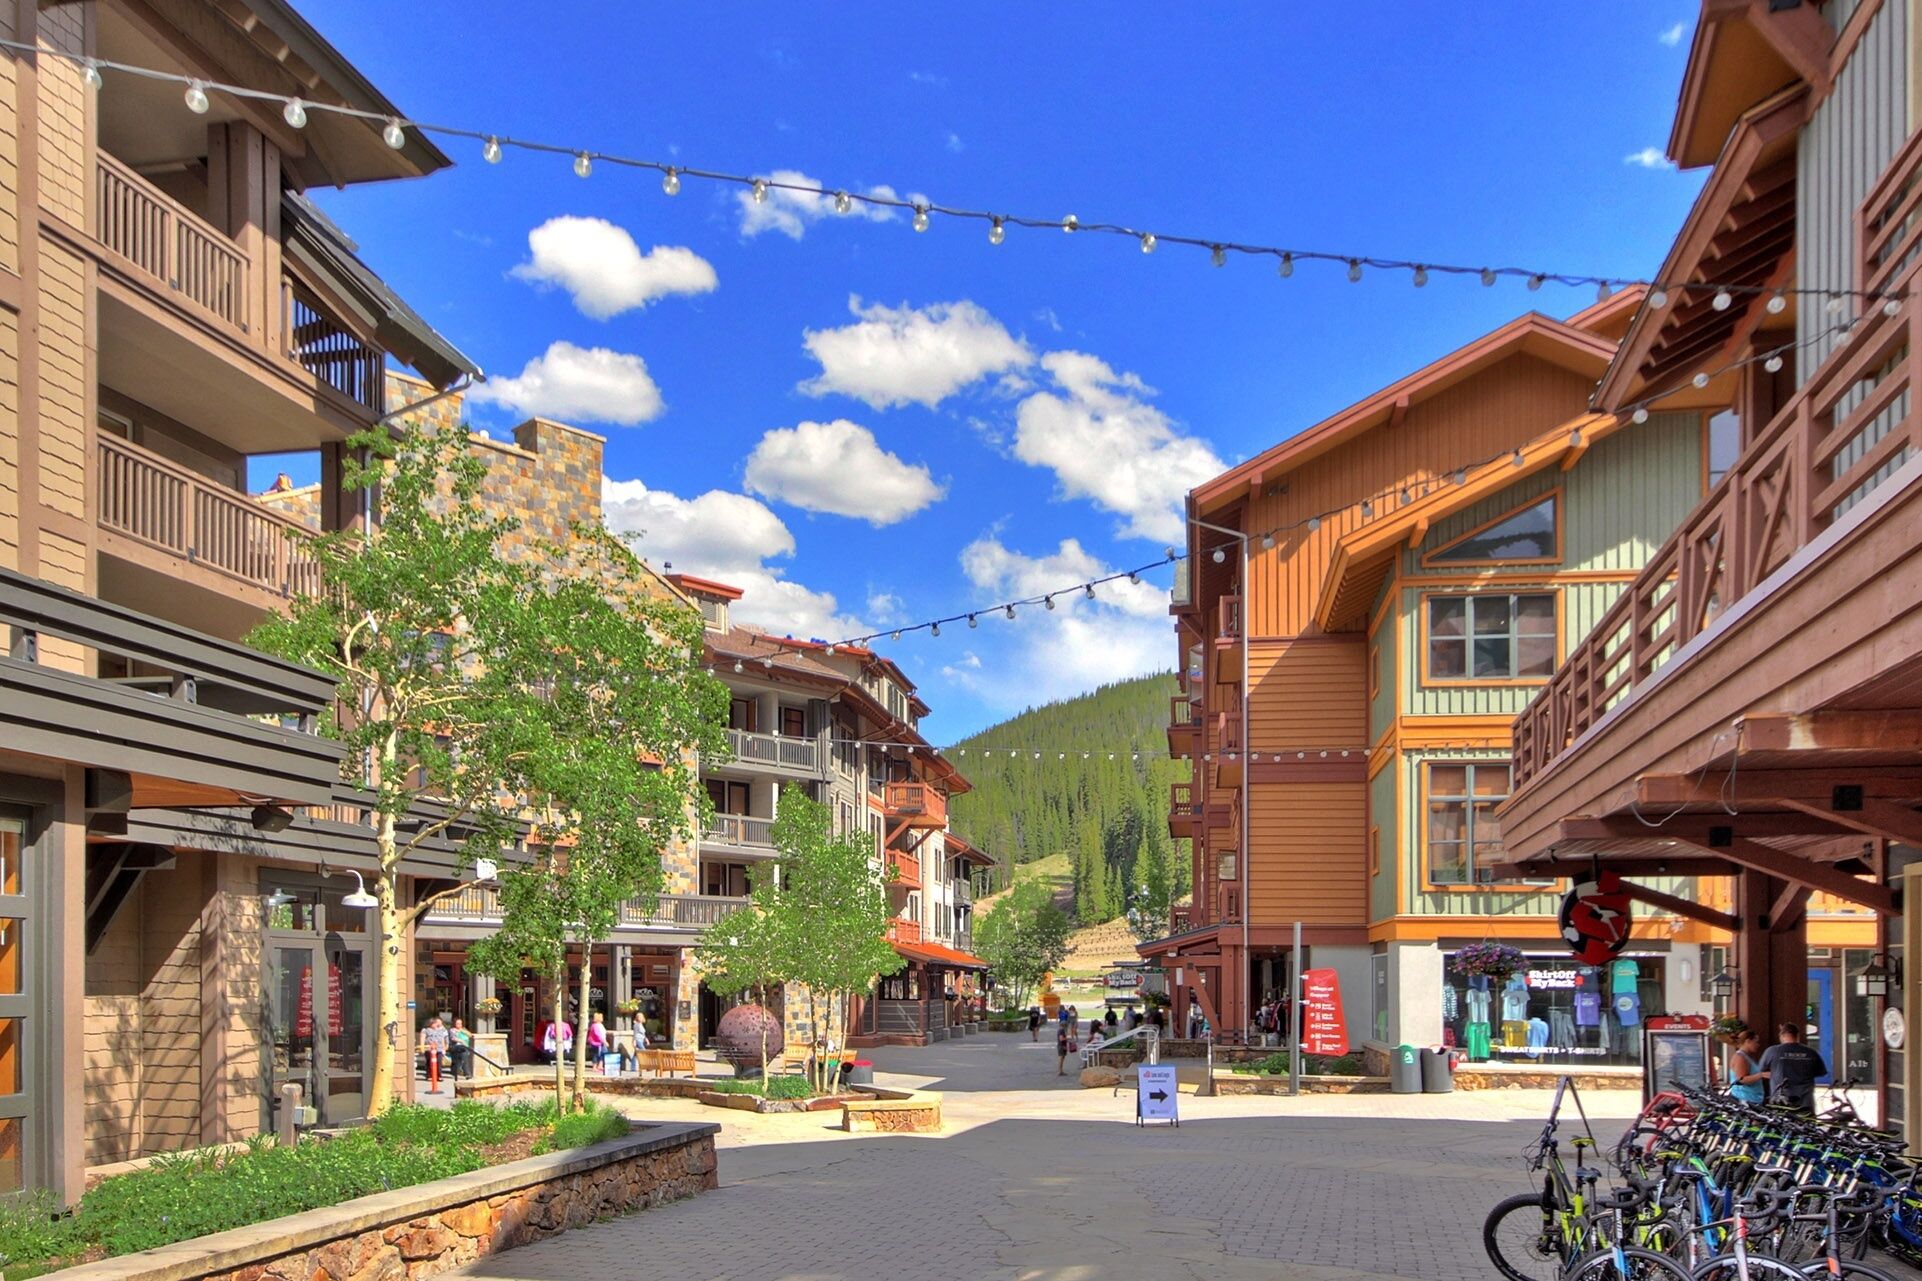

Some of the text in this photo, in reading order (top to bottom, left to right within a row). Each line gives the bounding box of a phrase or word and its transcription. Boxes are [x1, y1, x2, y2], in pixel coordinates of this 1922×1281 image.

[1528, 970, 1576, 979] ShirtOff
[1530, 979, 1576, 989] MyBack
[1500, 1045, 1607, 1055] SWEATSHIRTS T-SHIRTS
